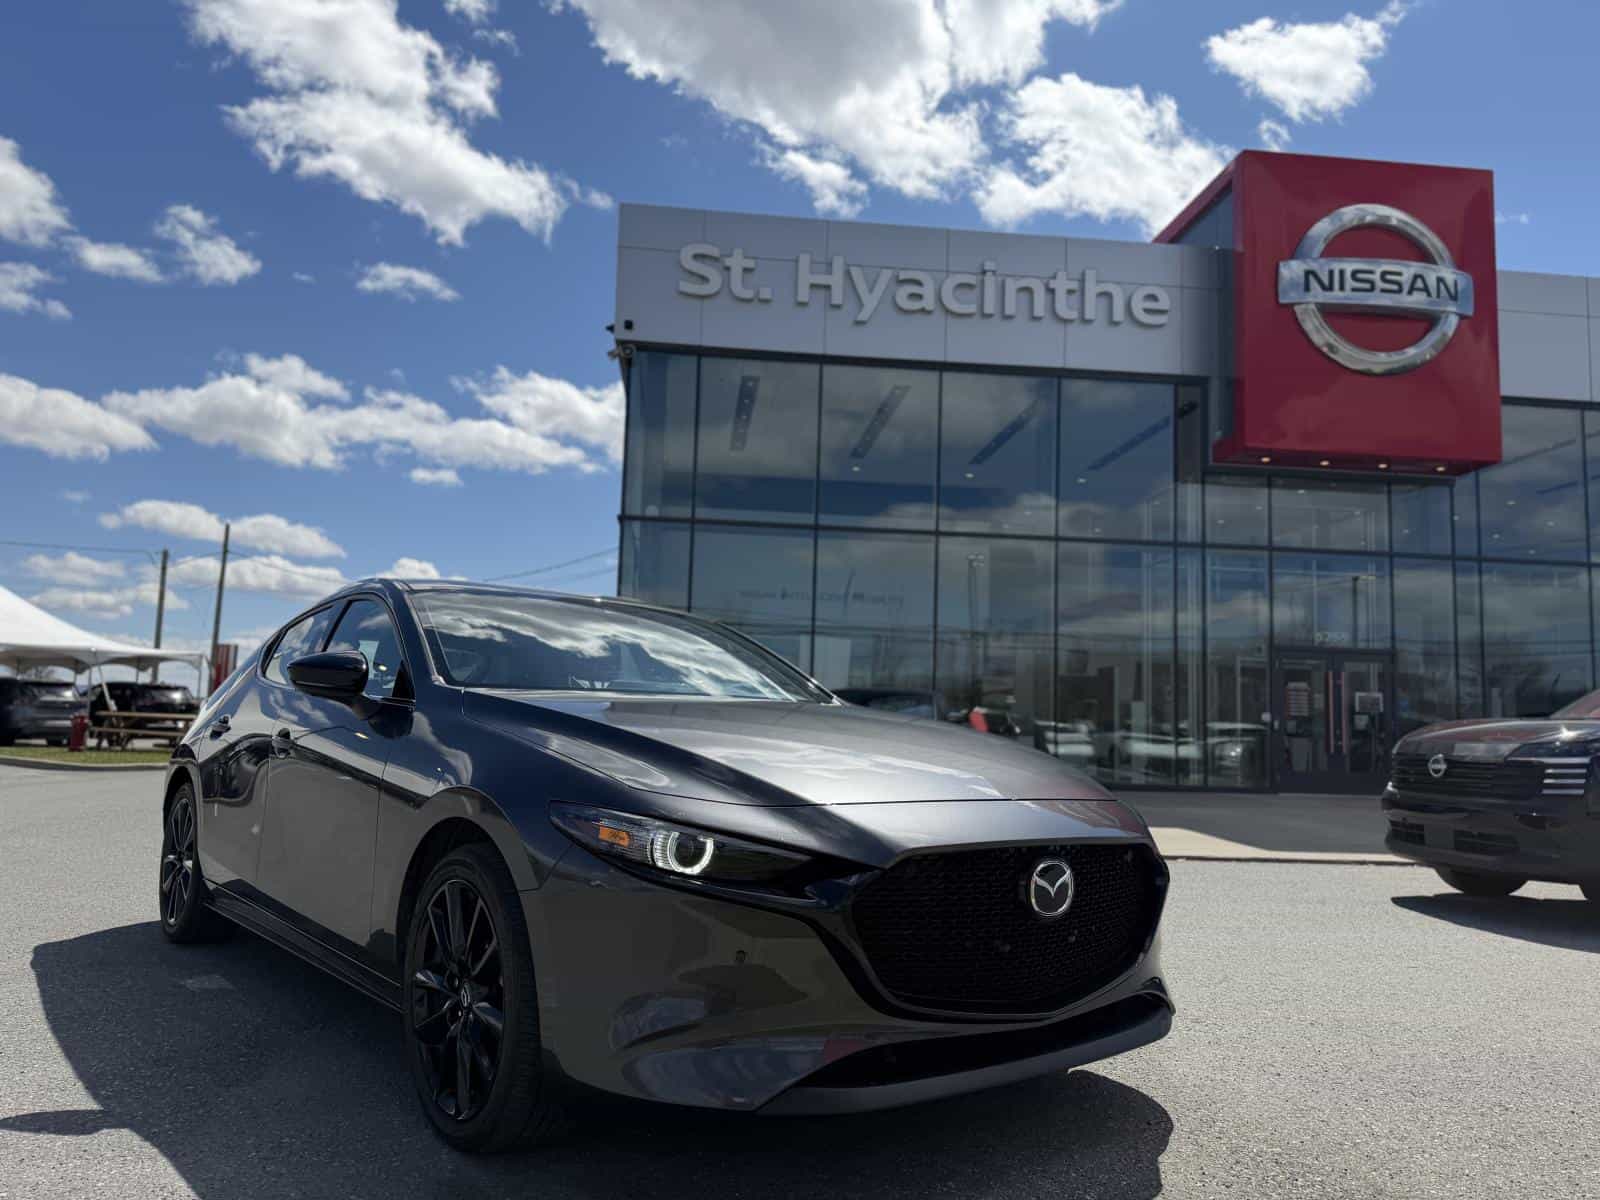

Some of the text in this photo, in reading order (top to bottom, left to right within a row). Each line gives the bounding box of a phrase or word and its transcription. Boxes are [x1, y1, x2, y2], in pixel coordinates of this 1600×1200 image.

[678, 242, 1171, 328] St. Hyacinthe
[1303, 268, 1459, 302] NISSAN
